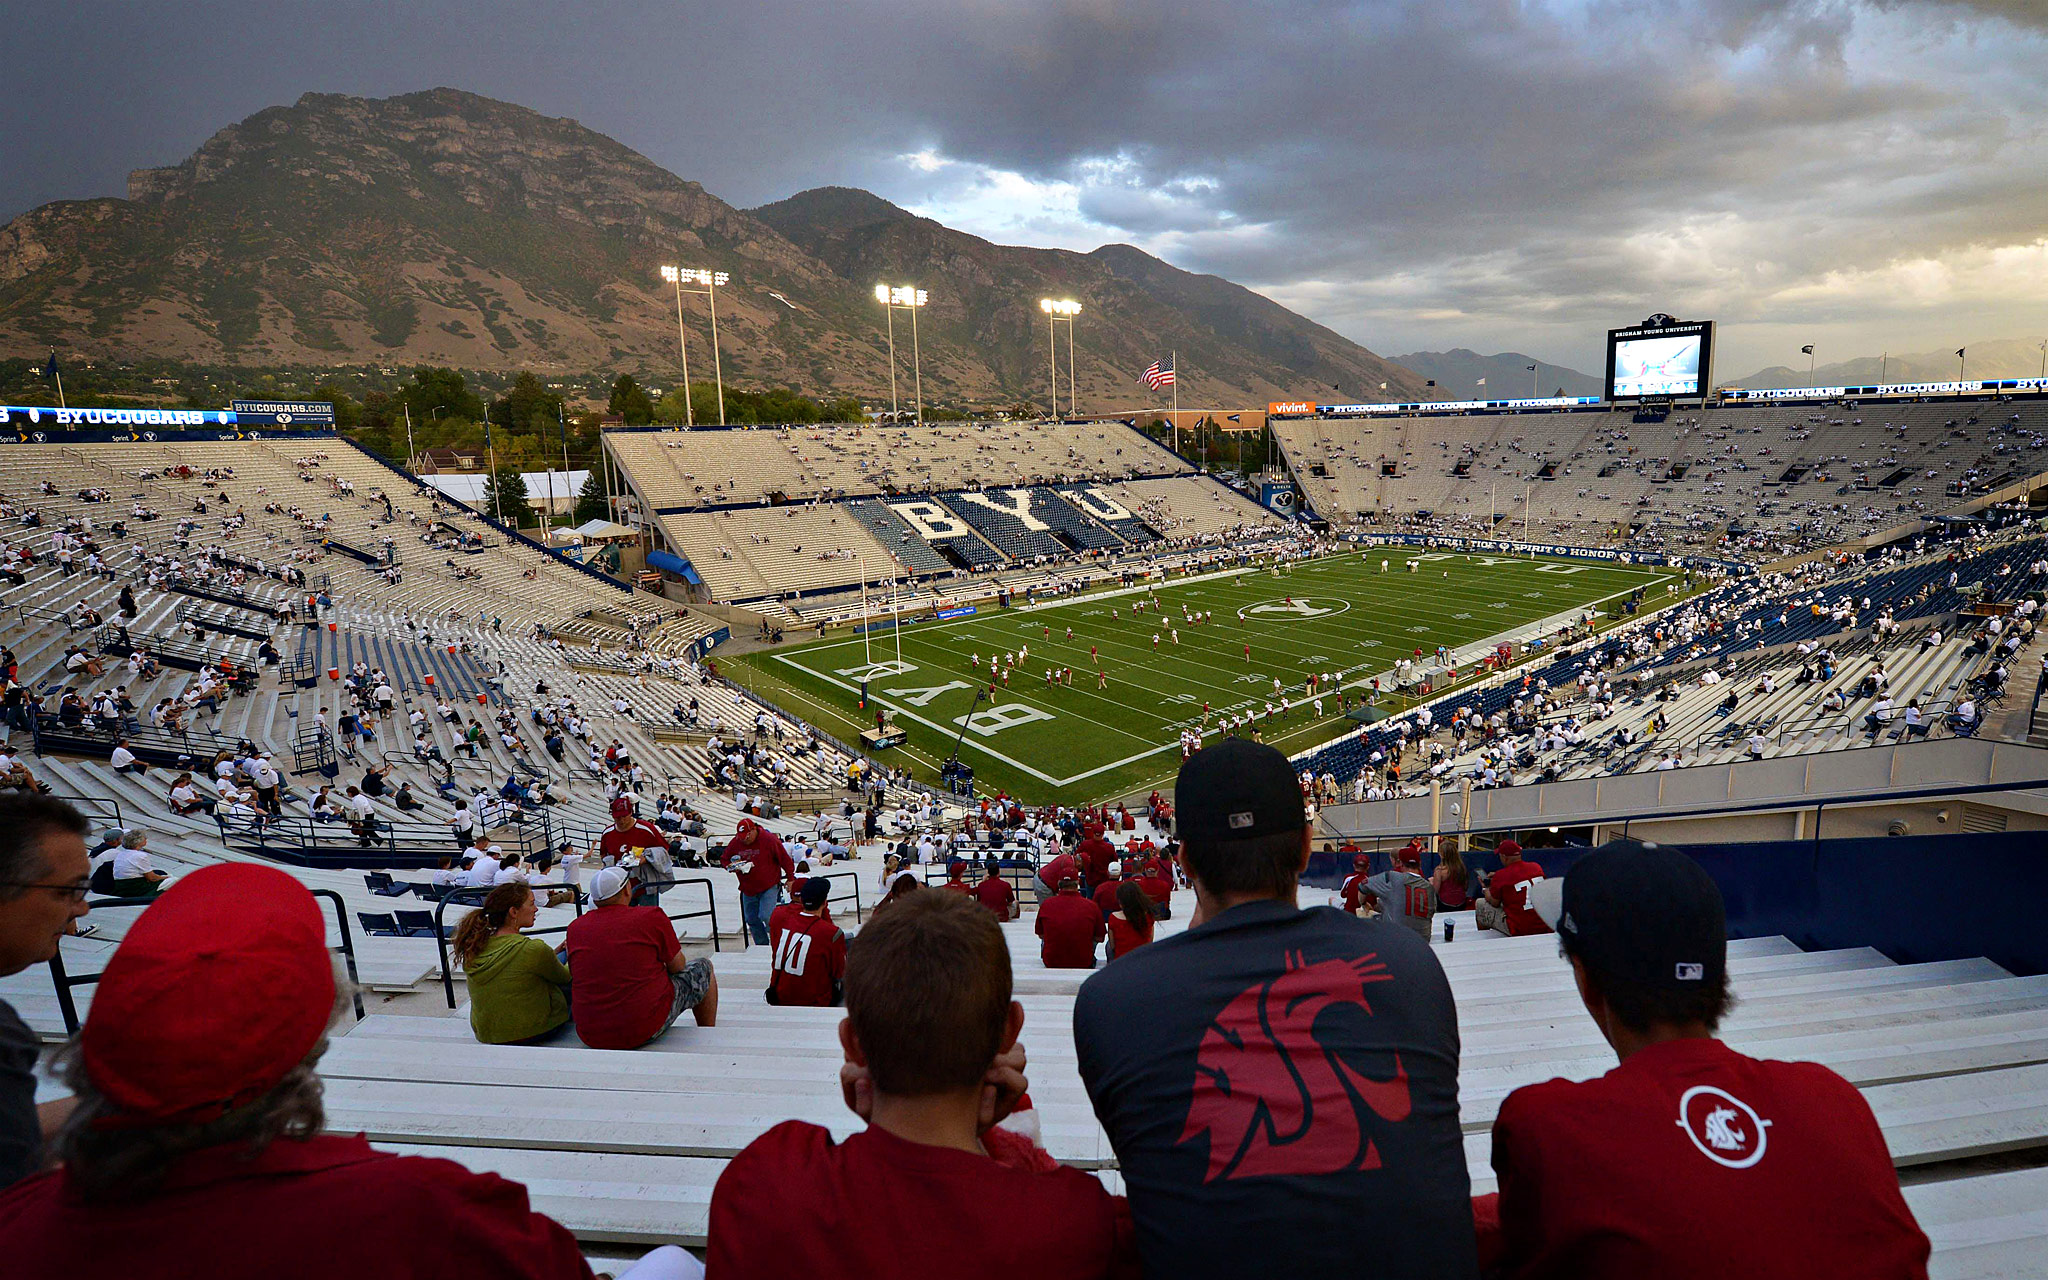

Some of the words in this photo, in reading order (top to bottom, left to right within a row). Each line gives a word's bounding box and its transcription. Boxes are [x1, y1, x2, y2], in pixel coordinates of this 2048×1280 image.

[1665, 325, 1703, 333] UNIVERSITY
[1748, 387, 1845, 399] BYUCOUGARS
[1876, 381, 1982, 394] BYUCOUGARS
[234, 403, 332, 413] BYUCOUGARS.COM
[55, 408, 204, 425] BYUCOUGARS
[889, 488, 1132, 540] BYU
[1514, 543, 1553, 555] SPIRIT
[1570, 548, 1616, 560] HONOR
[1165, 693, 1197, 705] 10
[1405, 884, 1429, 918] 10
[774, 928, 812, 976] 10
